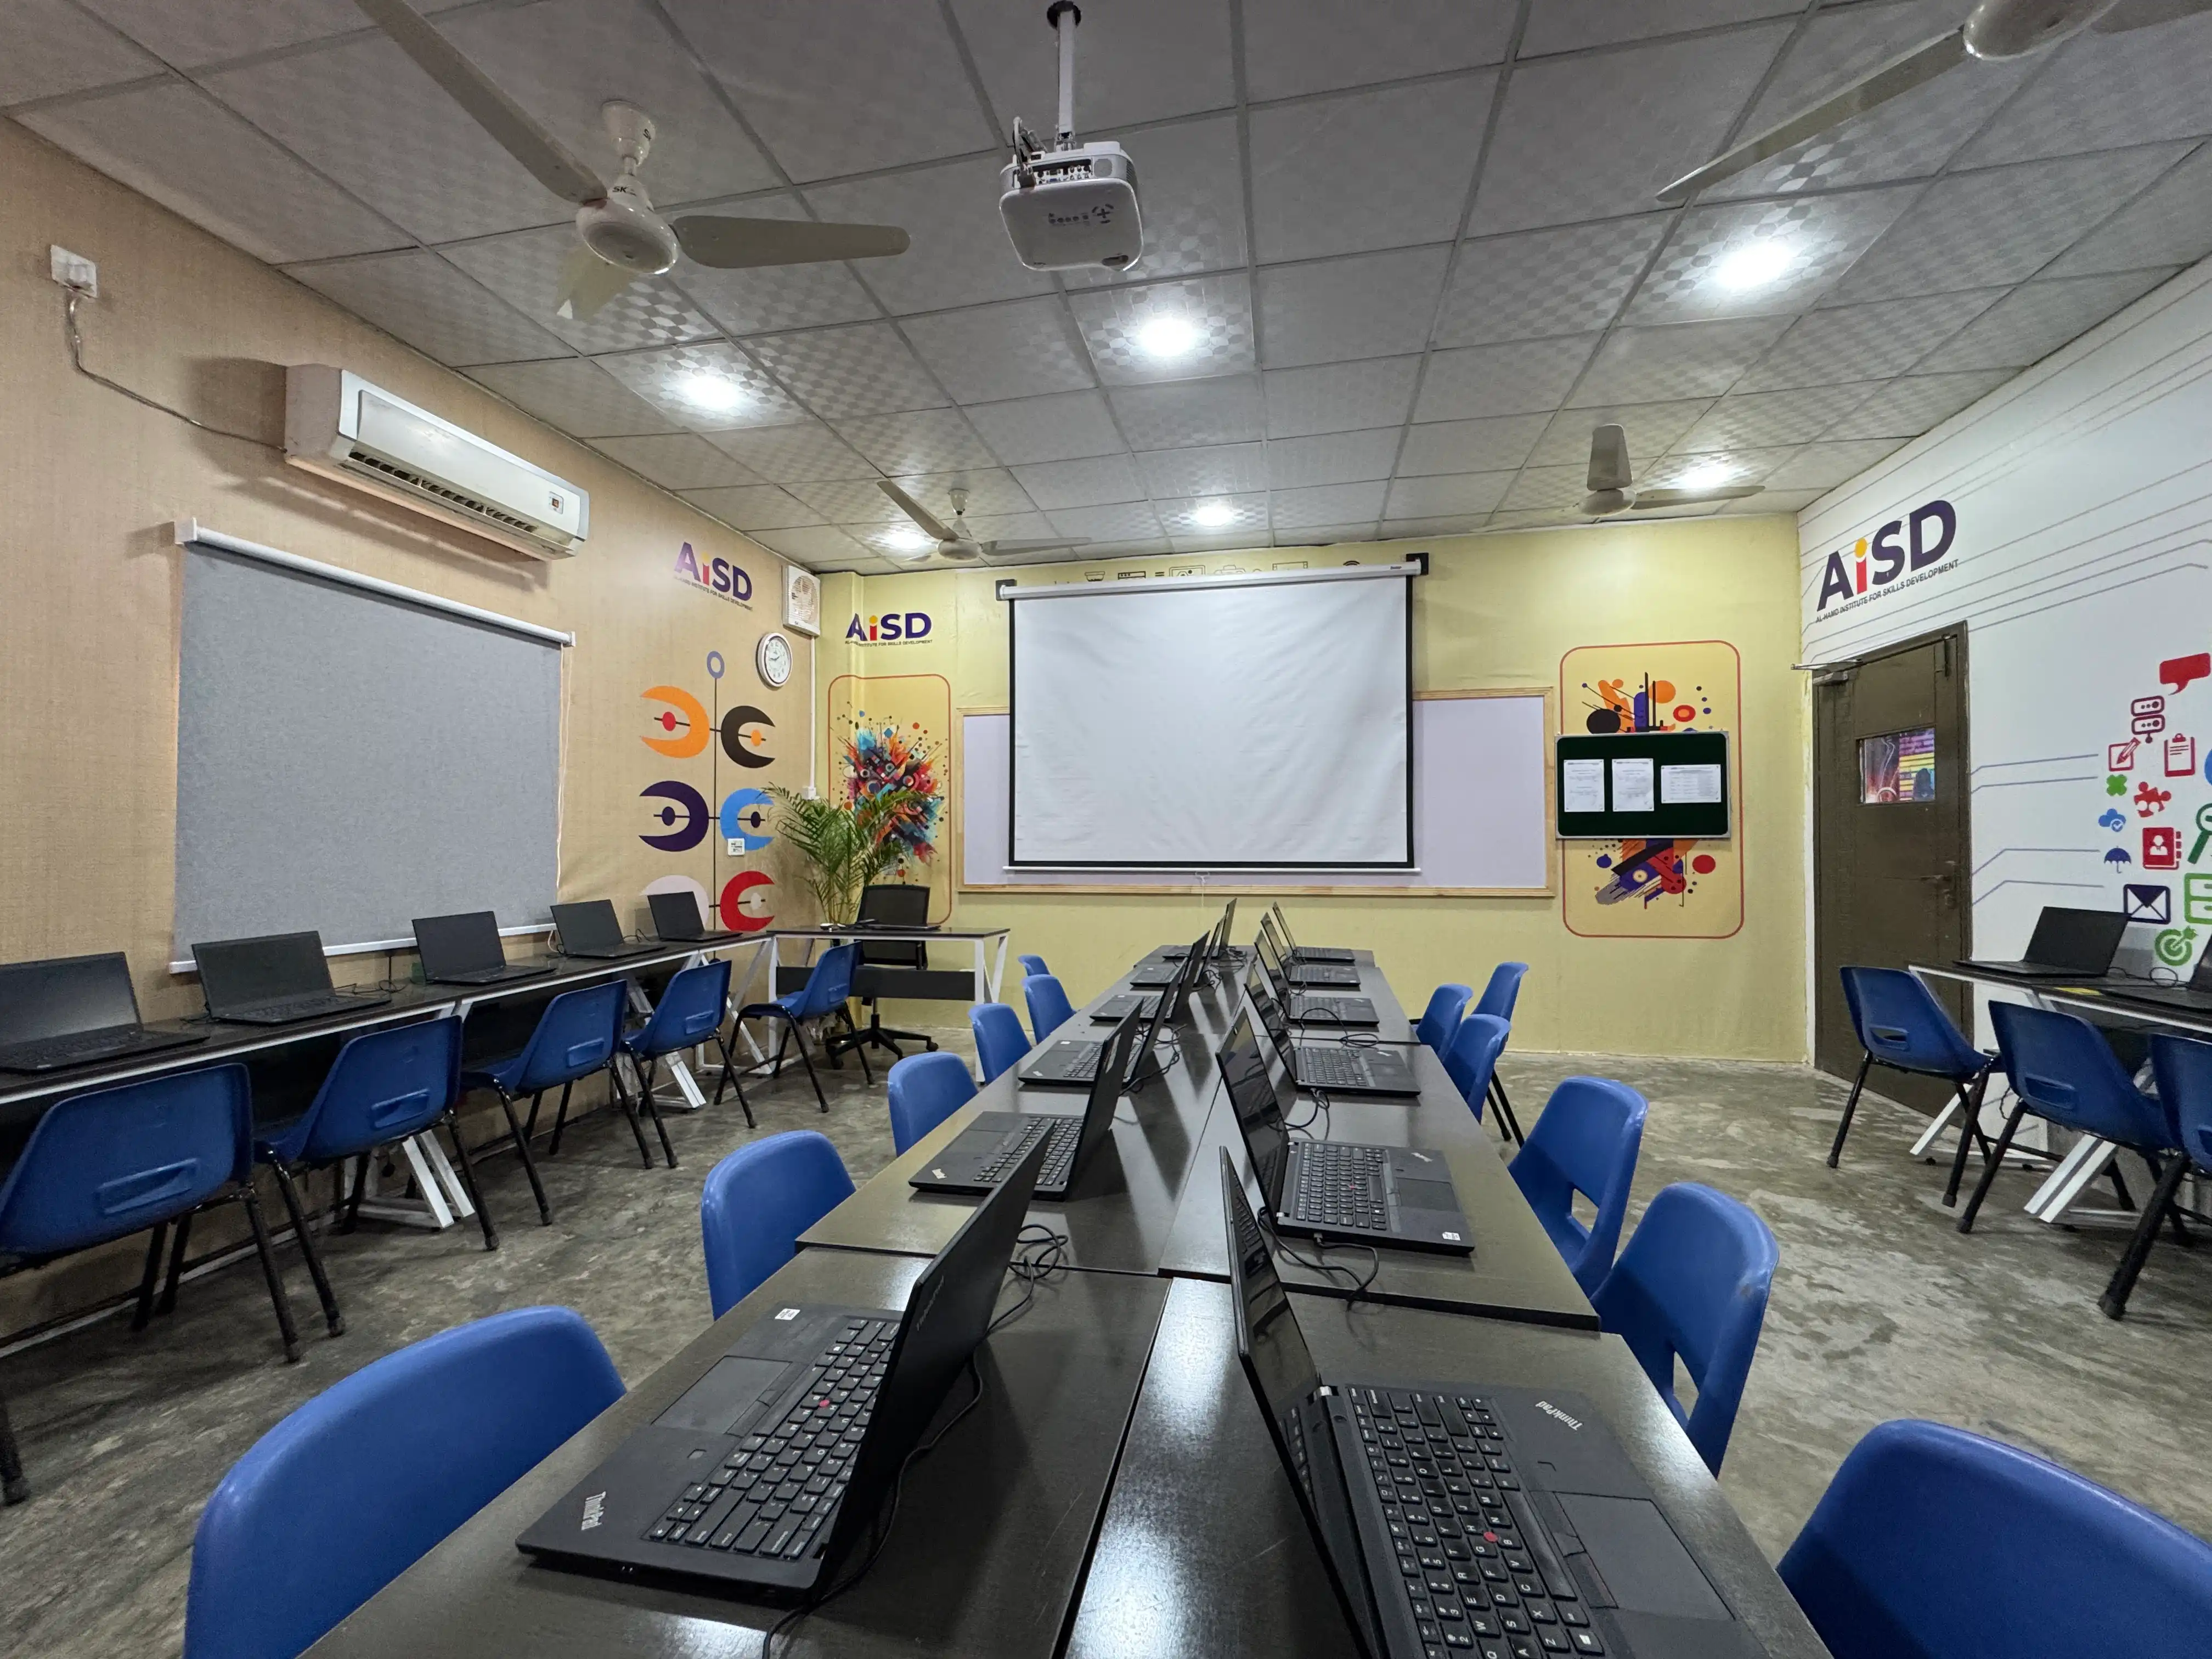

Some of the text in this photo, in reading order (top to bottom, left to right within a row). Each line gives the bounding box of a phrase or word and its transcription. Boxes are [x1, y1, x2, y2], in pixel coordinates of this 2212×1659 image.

[1817, 500, 1956, 612] AiSD
[1816, 559, 1959, 624] AL-HAMD INSTITUTE FOR SKILLS DEVELOPMENT
[845, 613, 932, 641] AiSD
[1535, 1401, 1583, 1431] ThinkPad
[1475, 1621, 1486, 1630] W
